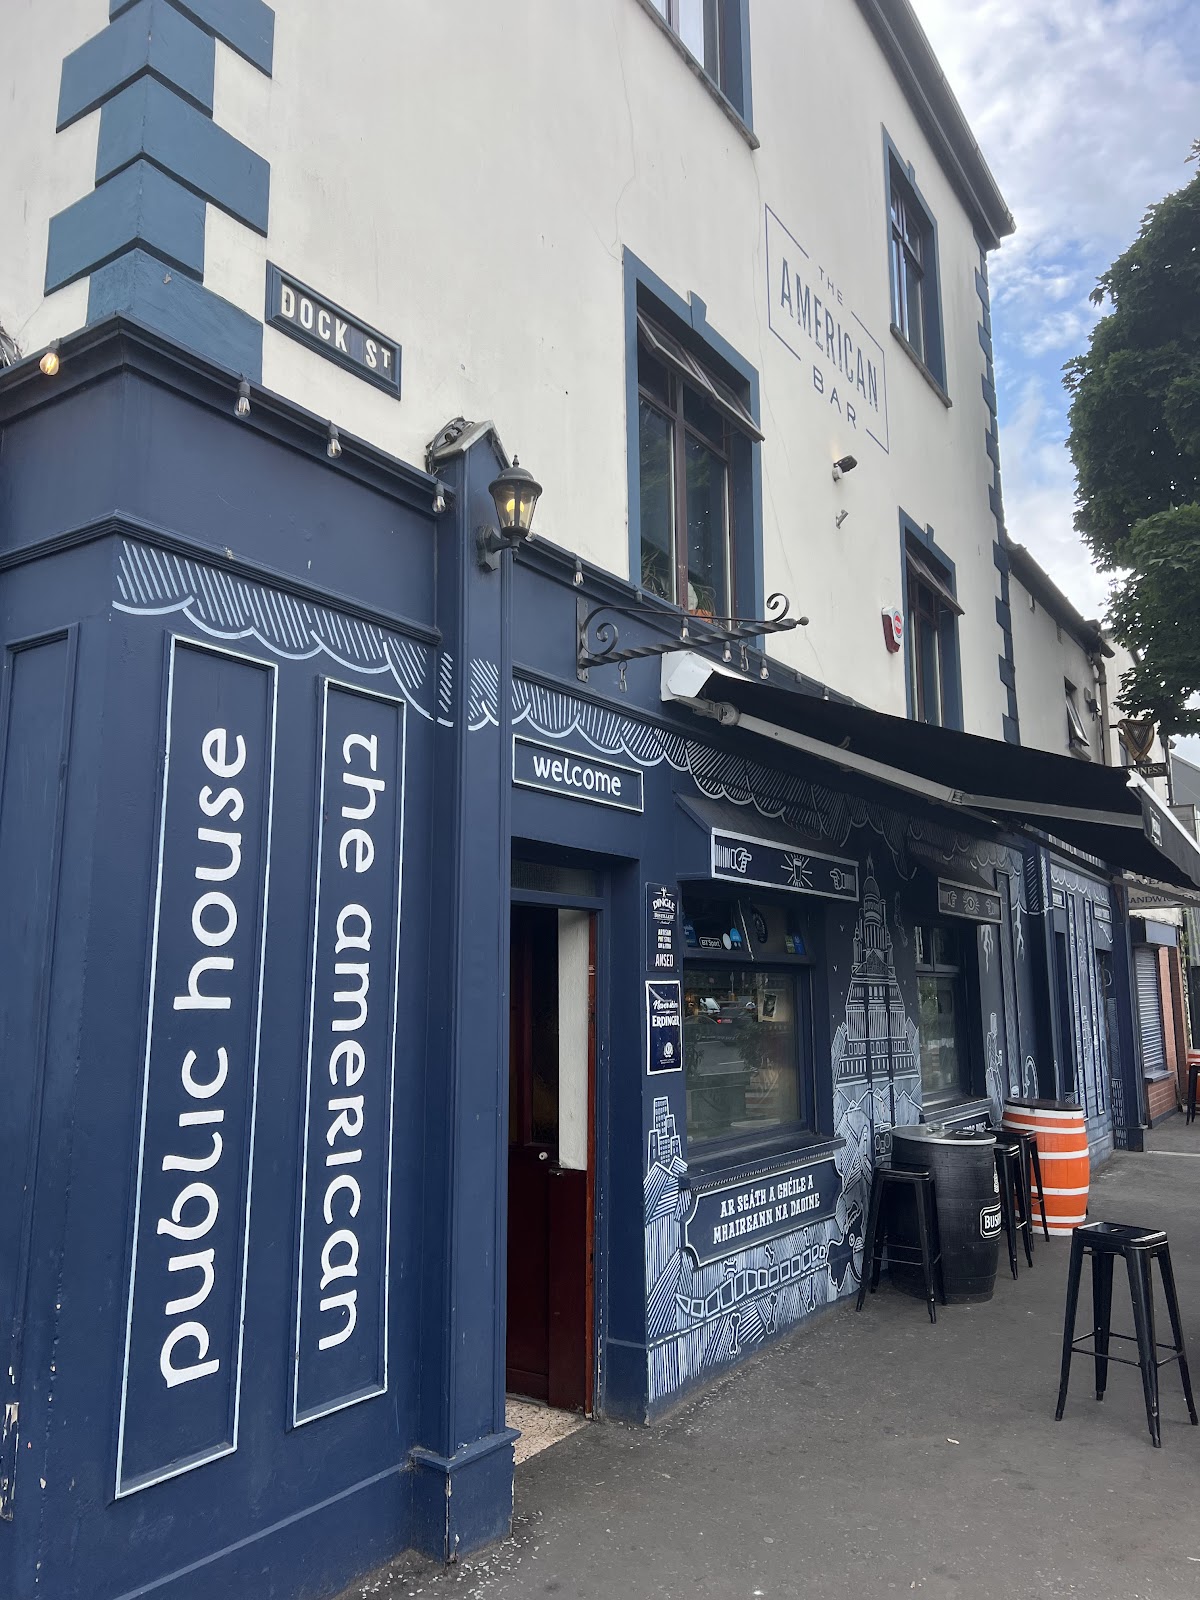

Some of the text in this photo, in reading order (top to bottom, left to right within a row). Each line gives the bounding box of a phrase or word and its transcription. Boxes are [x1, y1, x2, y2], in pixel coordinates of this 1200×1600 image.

[818, 265, 843, 306] THE
[281, 283, 391, 369] DOCK ST
[780, 257, 879, 412] AMERICAN
[812, 365, 857, 429] BAR
[533, 755, 622, 796] welcome
[652, 898, 676, 912] DINGLE
[654, 953, 674, 967] ANSEO
[318, 734, 386, 1351] the american
[652, 1015, 680, 1028] ERDINGER
[157, 727, 247, 1388] public house
[713, 1193, 821, 1244] MHAIREANN NA DAOINE
[720, 1198, 735, 1218] AR
[769, 1186, 776, 1204] A
[808, 1174, 814, 1189] A
